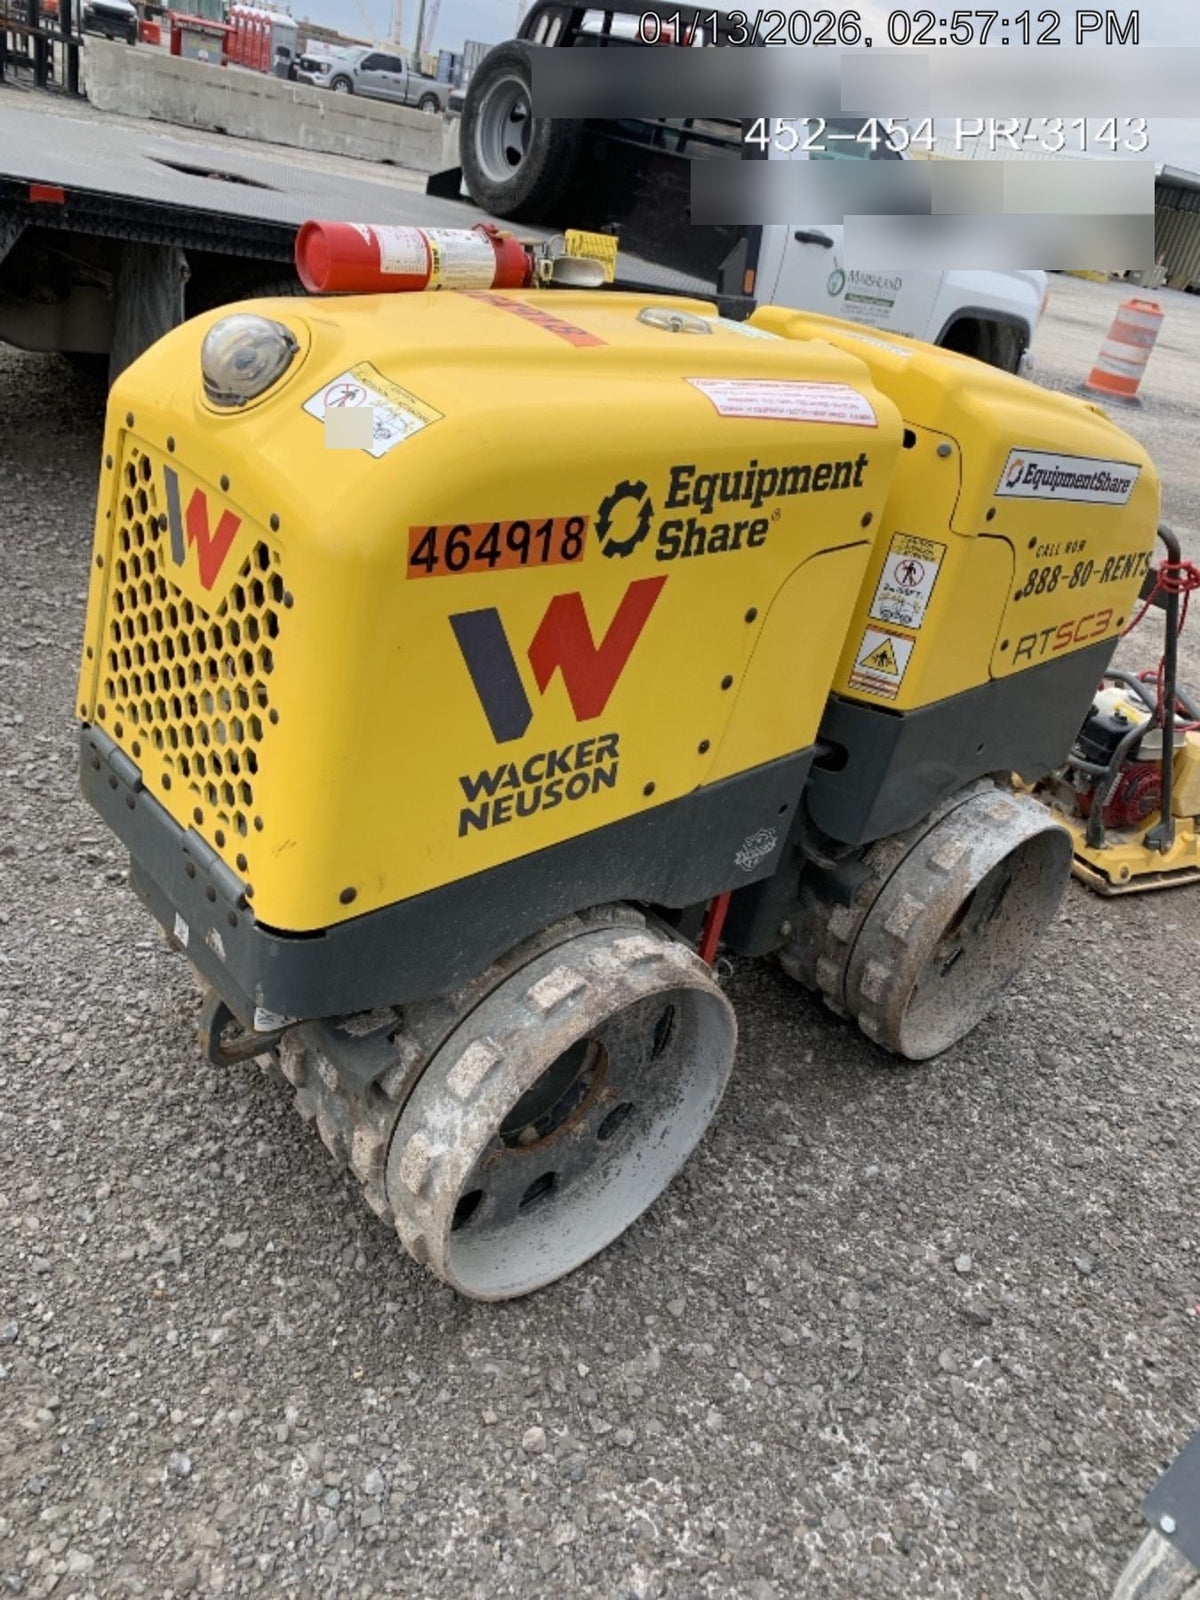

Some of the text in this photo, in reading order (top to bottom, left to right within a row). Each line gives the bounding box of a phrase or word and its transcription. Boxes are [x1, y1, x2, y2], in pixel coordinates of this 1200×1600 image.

[663, 453, 868, 516] Equipment
[1022, 462, 1130, 494] EquipmentShare
[409, 516, 585, 574] 464918
[1012, 608, 1113, 665] RTSC3
[458, 732, 620, 802] WACKER
[457, 763, 619, 838] NEUSON
